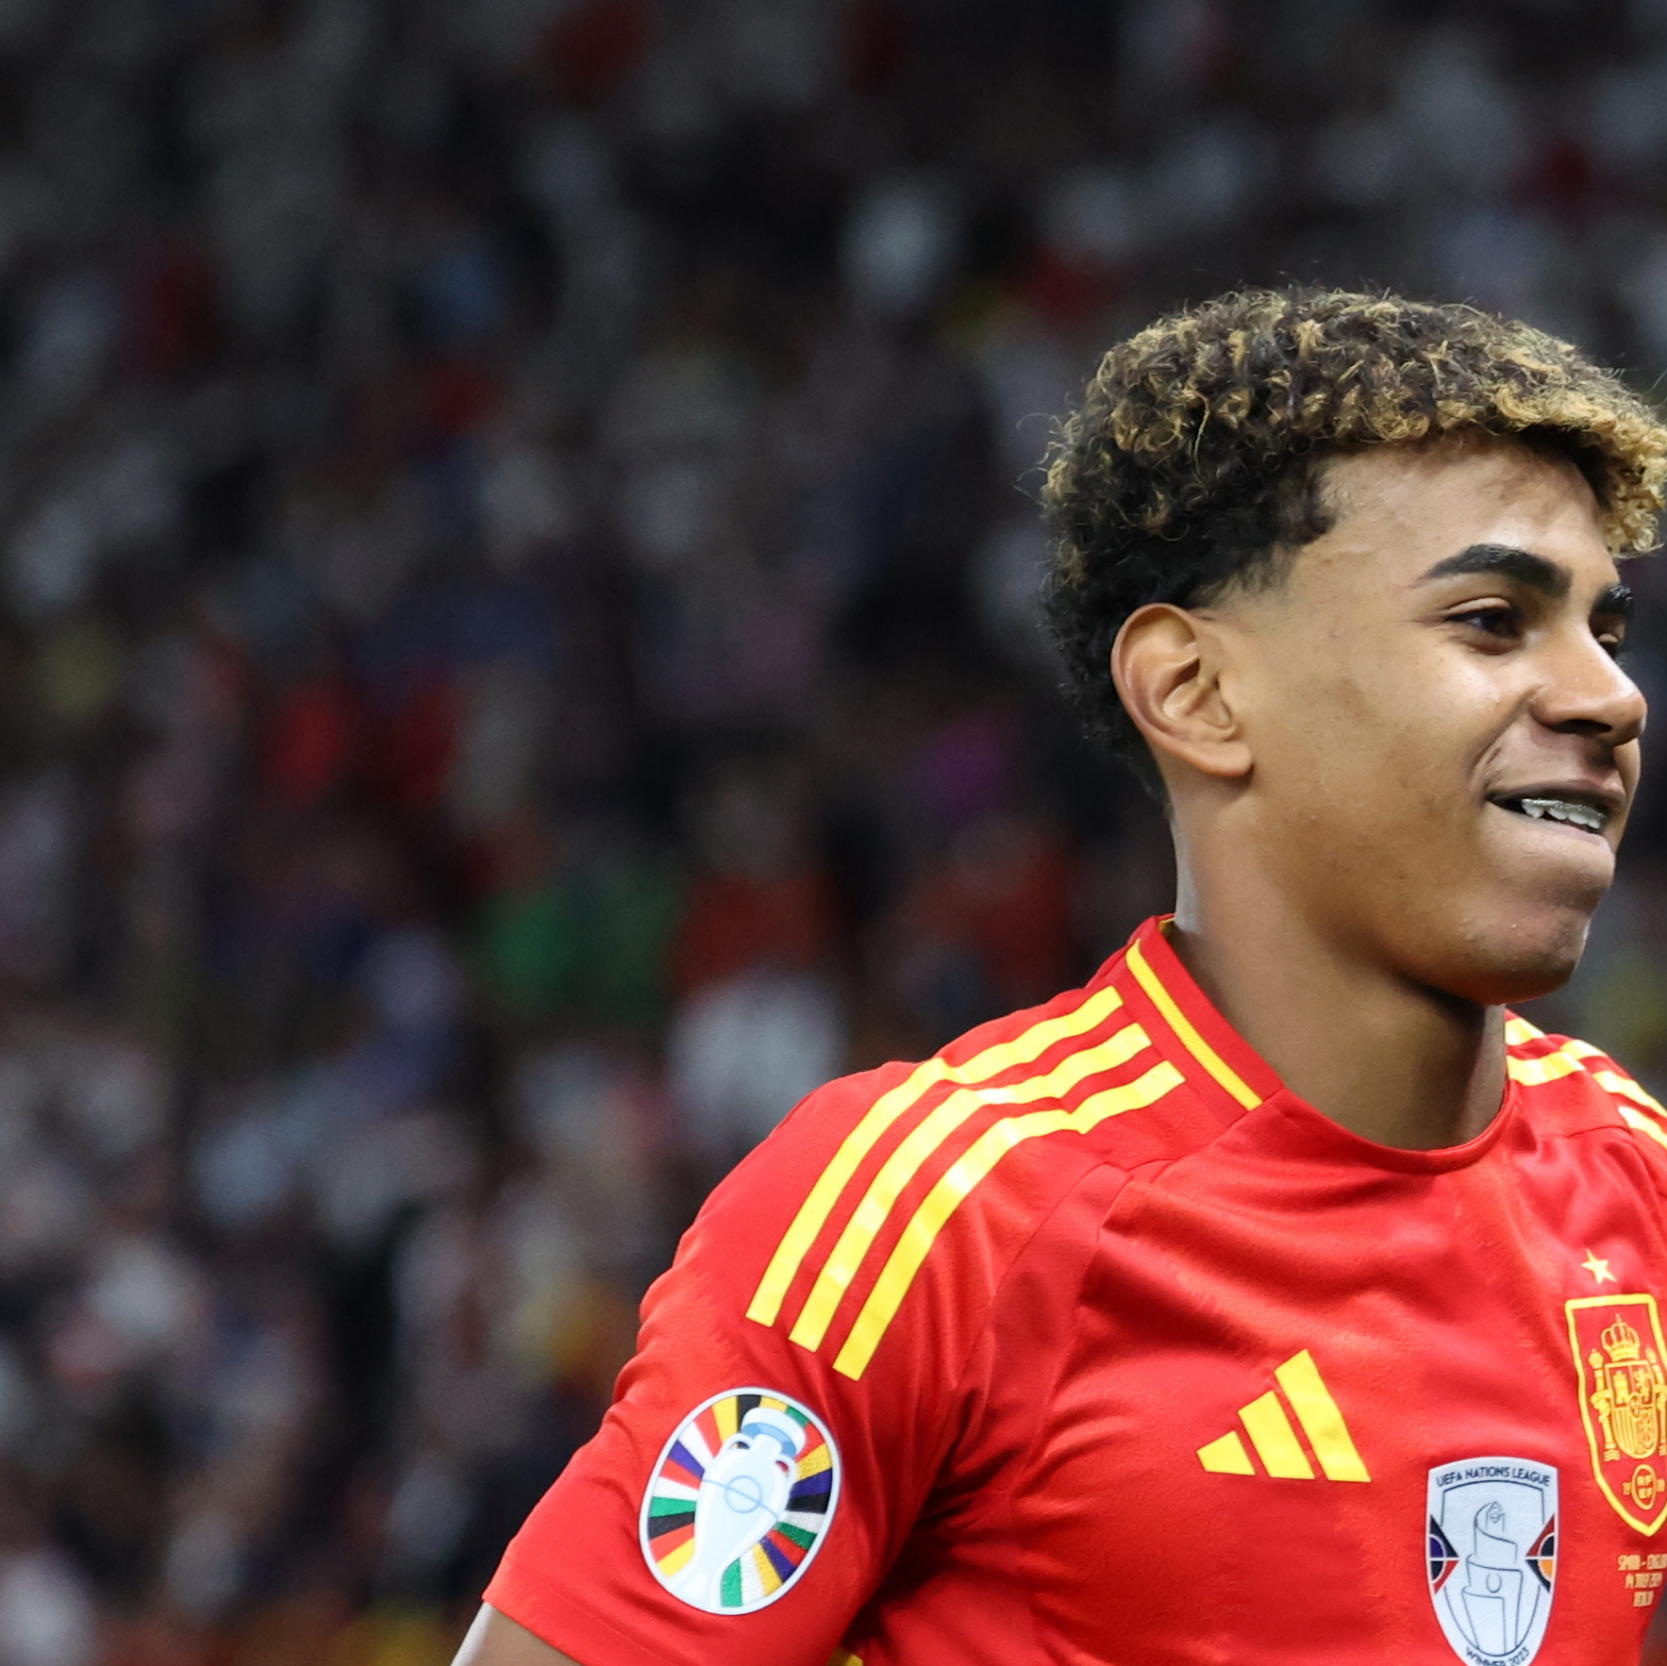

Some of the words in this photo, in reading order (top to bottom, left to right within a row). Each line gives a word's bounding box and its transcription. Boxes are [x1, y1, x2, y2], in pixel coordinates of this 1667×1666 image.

[1436, 1471, 1463, 1487] UEFA
[1465, 1466, 1510, 1480] NATIONS
[1512, 1467, 1552, 1487] LEAGUE
